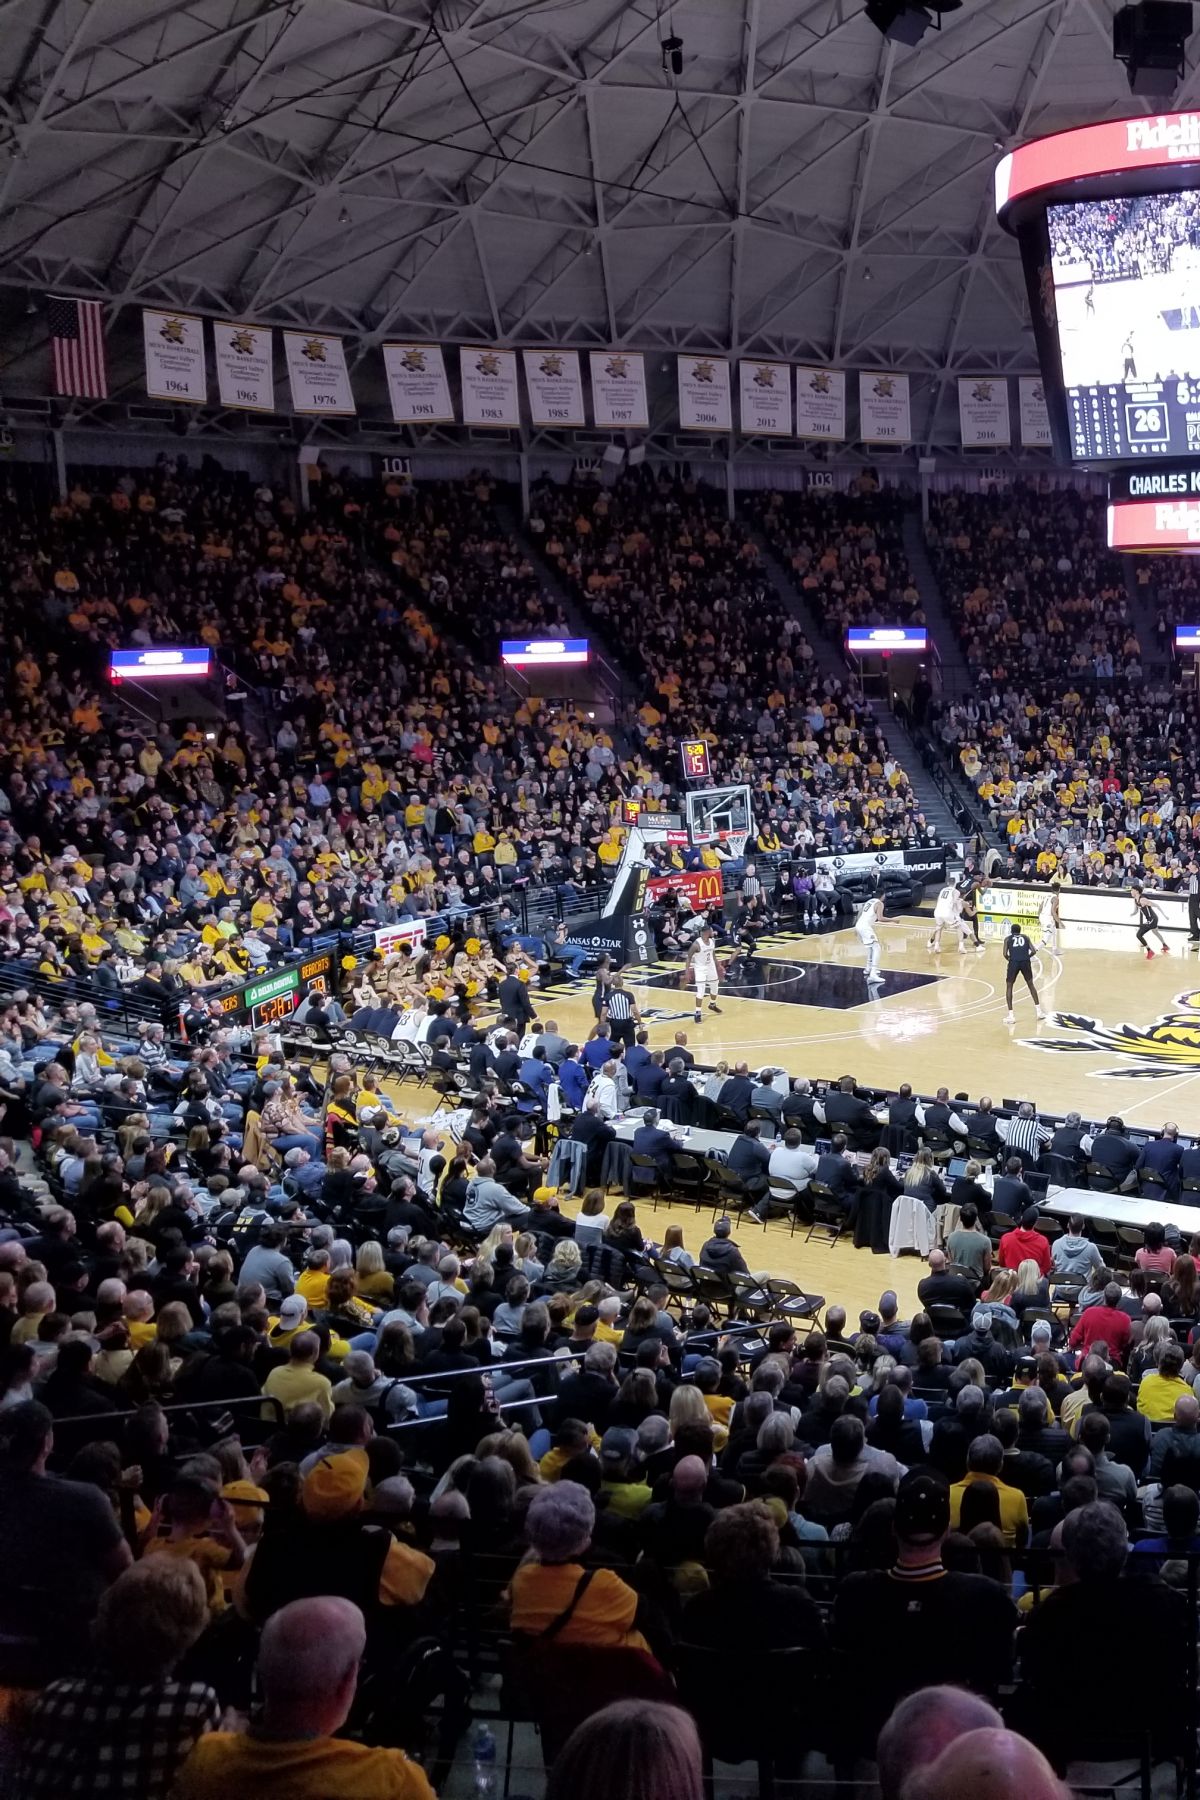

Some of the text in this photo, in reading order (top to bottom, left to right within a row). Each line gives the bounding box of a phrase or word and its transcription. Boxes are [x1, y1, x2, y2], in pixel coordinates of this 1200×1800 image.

[165, 380, 189, 393] 1964
[236, 389, 258, 402] 1965
[312, 394, 336, 405] 1976
[412, 404, 435, 415] 1981
[480, 408, 504, 419] 1983
[547, 408, 570, 418] 1985
[611, 410, 633, 420] 1987
[695, 412, 717, 424] 2006
[756, 417, 777, 428] 2012
[1134, 408, 1161, 432] 26
[811, 422, 831, 433] 2014
[876, 426, 896, 436] 2015
[976, 431, 996, 439] 2016
[381, 457, 412, 473] 101
[574, 456, 601, 471] 102
[807, 471, 833, 488] 103
[1129, 474, 1188, 495] CHARLES
[692, 756, 704, 773] 15
[635, 868, 650, 911] WSU
[564, 935, 622, 948] KANSAS STAR
[1012, 936, 1025, 947] 20
[301, 957, 330, 979] BEARCATS
[257, 983, 273, 997] DELTA
[260, 997, 285, 1025] 5:28
